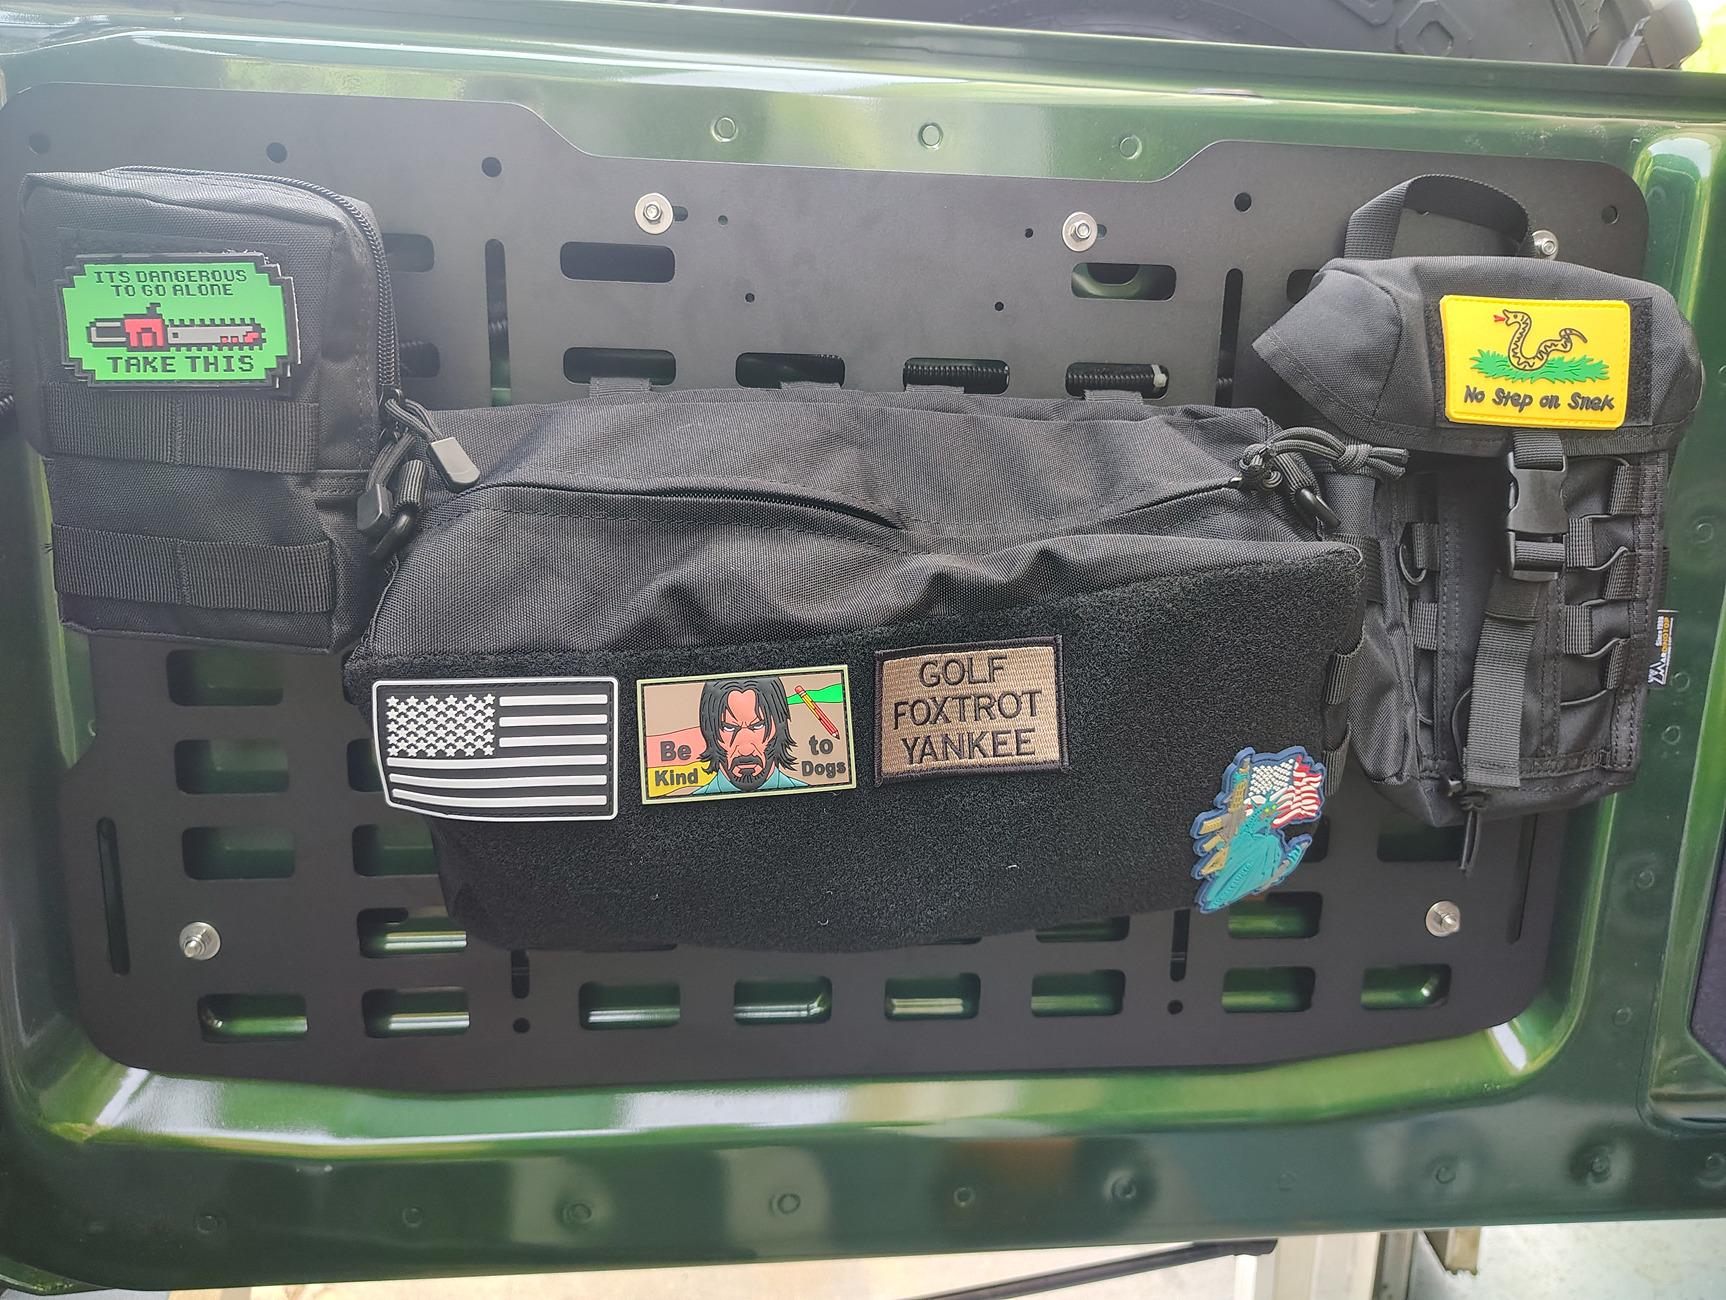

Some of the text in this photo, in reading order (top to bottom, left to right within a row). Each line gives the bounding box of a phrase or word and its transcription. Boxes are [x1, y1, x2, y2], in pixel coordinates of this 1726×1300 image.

[94, 269, 247, 283] ITS DANGEROUS
[111, 284, 234, 297] TO GO ALONE
[107, 355, 254, 373] TAKE THIS
[1464, 385, 1615, 412] No Step on Snek
[918, 655, 1008, 687] GOLF
[893, 690, 1042, 730] FOXTROT
[660, 740, 692, 761] Be
[808, 735, 834, 756] to
[902, 728, 1035, 765] YANKEE
[655, 768, 698, 786] Kind
[801, 760, 846, 778] Dogs
